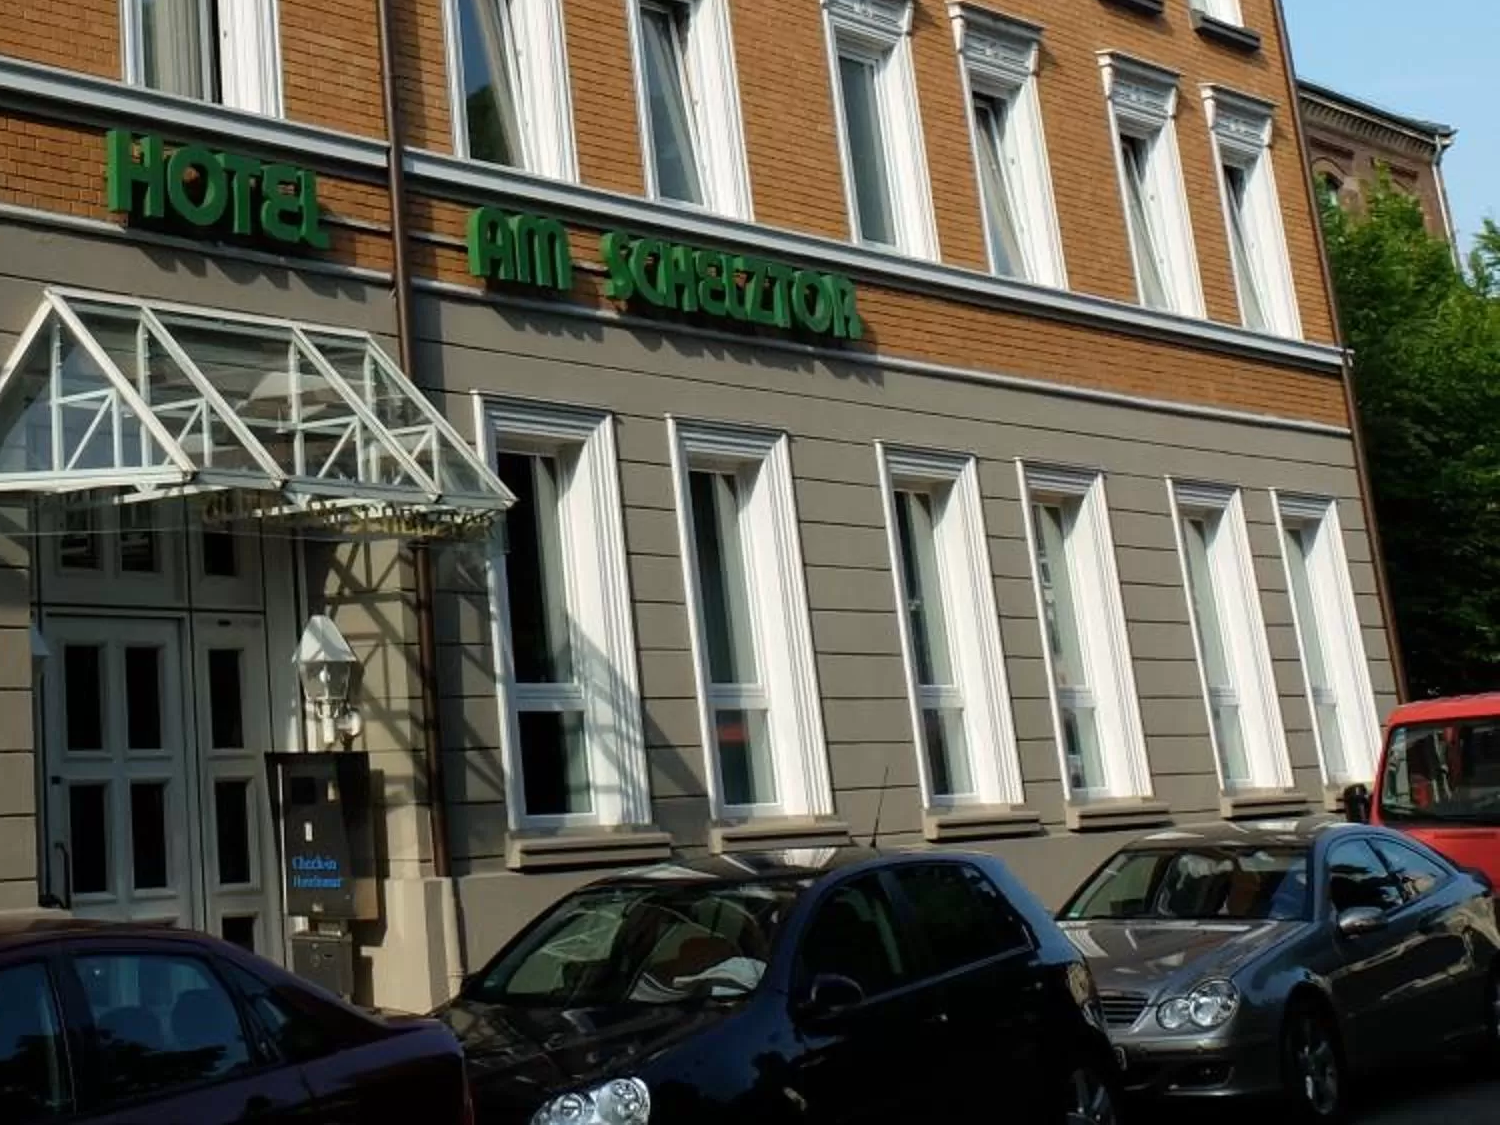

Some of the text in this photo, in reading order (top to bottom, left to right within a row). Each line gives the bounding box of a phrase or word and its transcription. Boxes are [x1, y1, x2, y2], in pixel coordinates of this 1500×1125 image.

[106, 130, 863, 340] HOTEL AM SCHELZTOR
